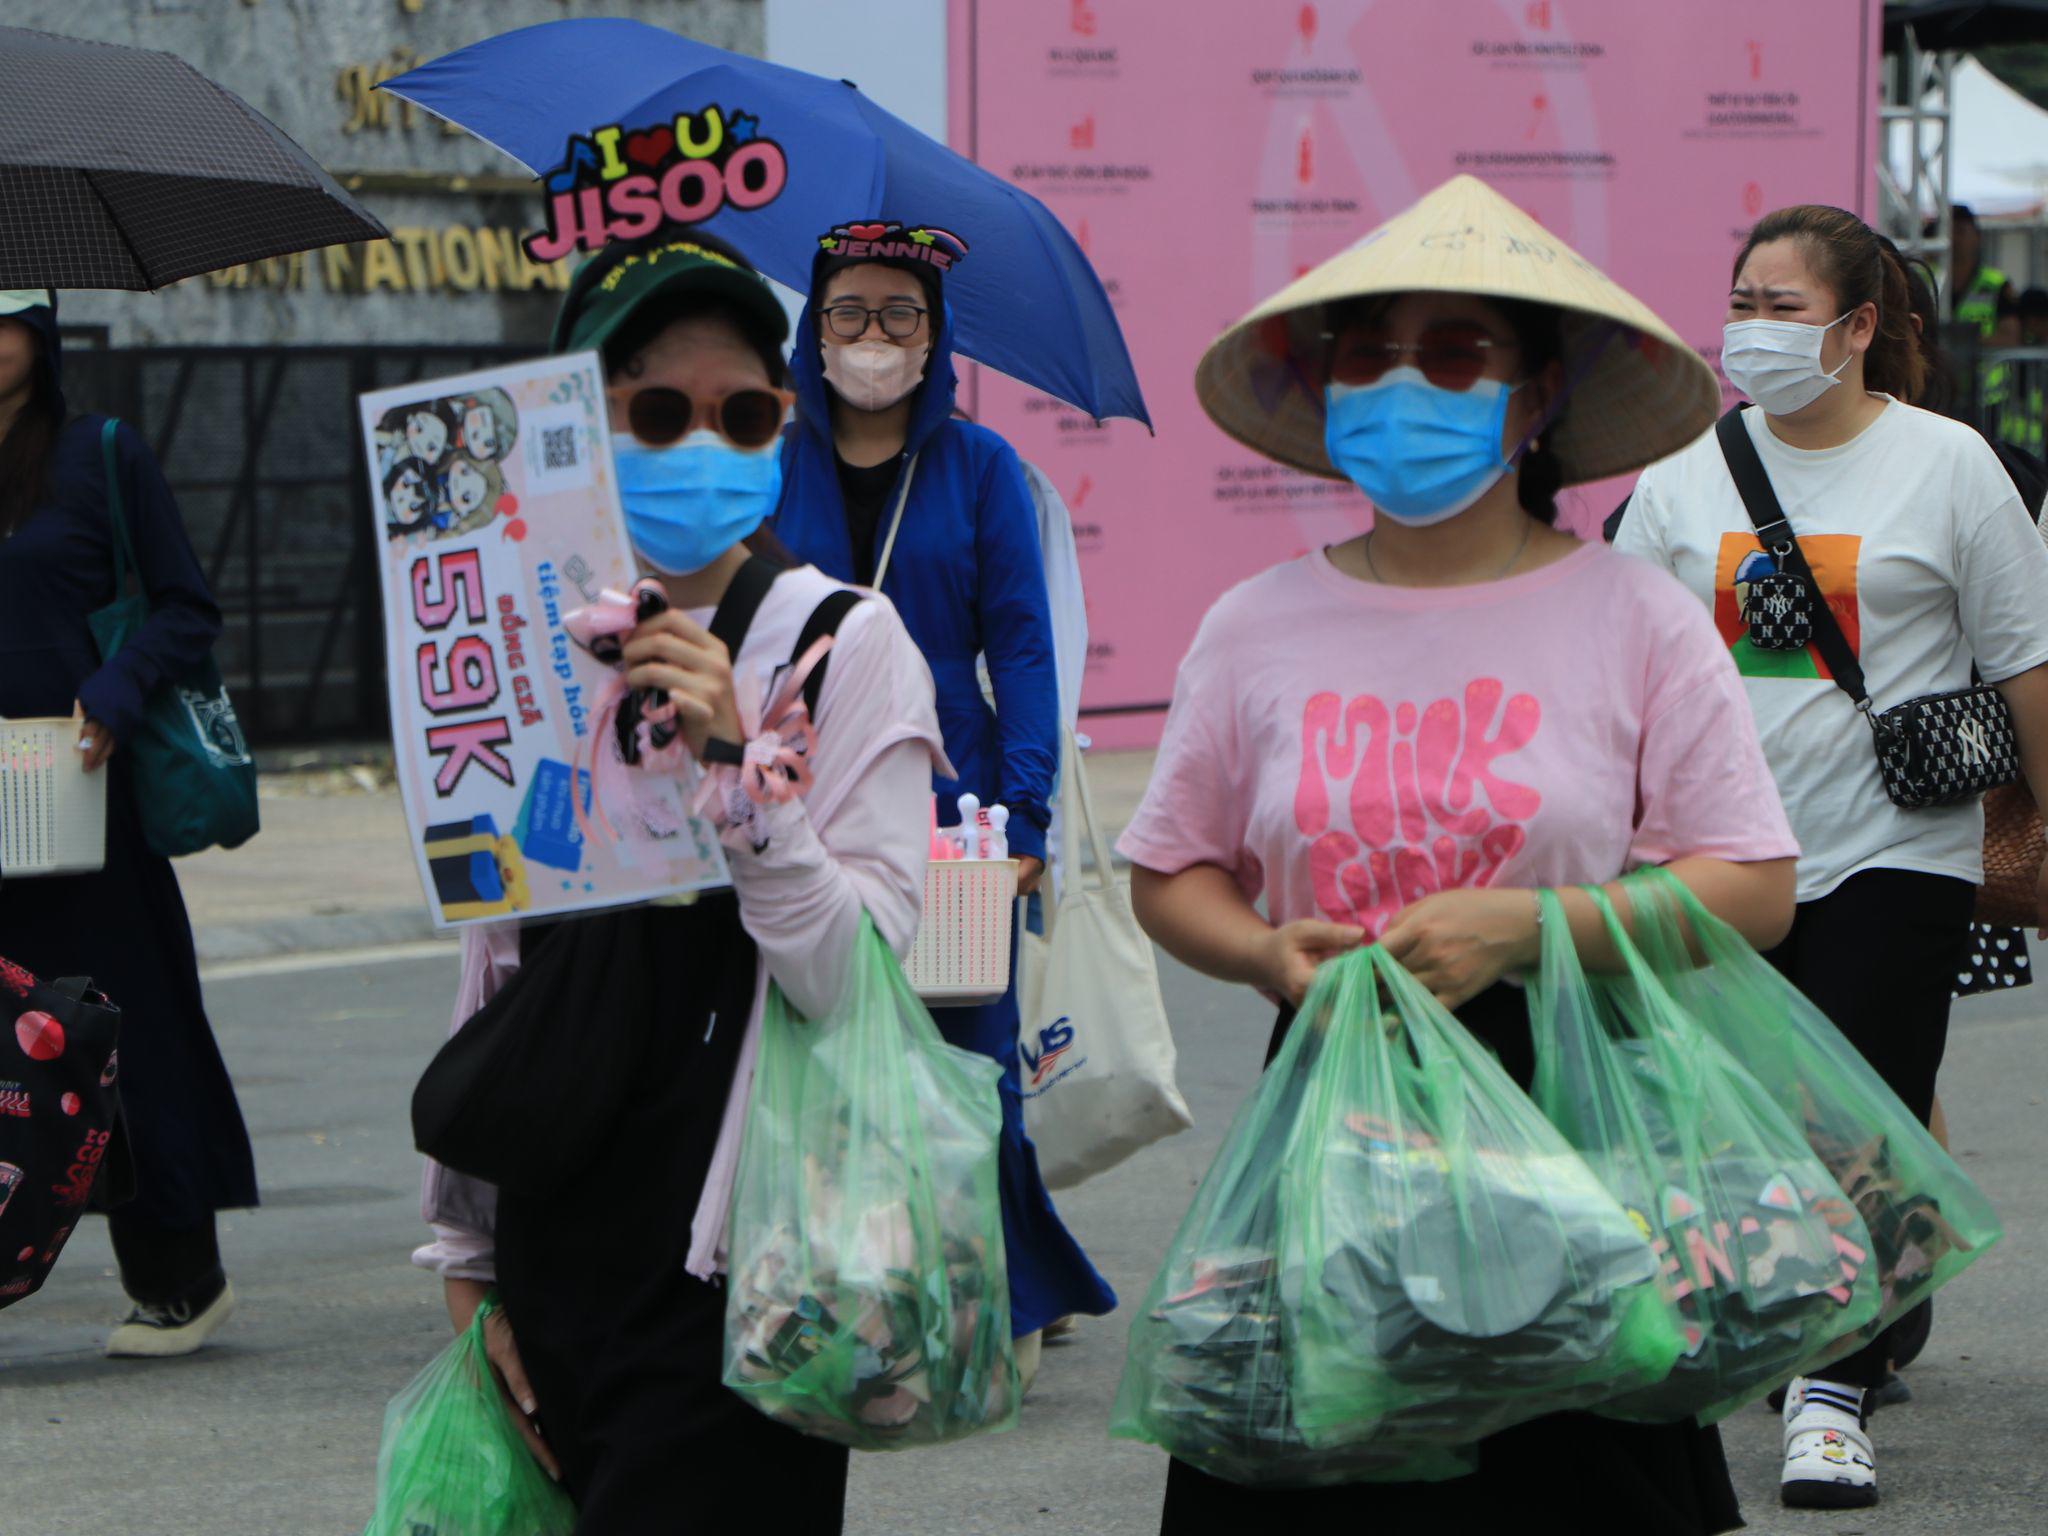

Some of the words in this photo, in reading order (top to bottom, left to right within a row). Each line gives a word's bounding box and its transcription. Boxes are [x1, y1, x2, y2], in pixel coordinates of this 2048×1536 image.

[528, 141, 787, 261] JISOO
[594, 126, 629, 181] I
[675, 106, 724, 159] U
[827, 239, 953, 271] JENNIE
[411, 547, 516, 799] 59K
[537, 561, 561, 628] tiệm
[550, 632, 573, 681] tạp
